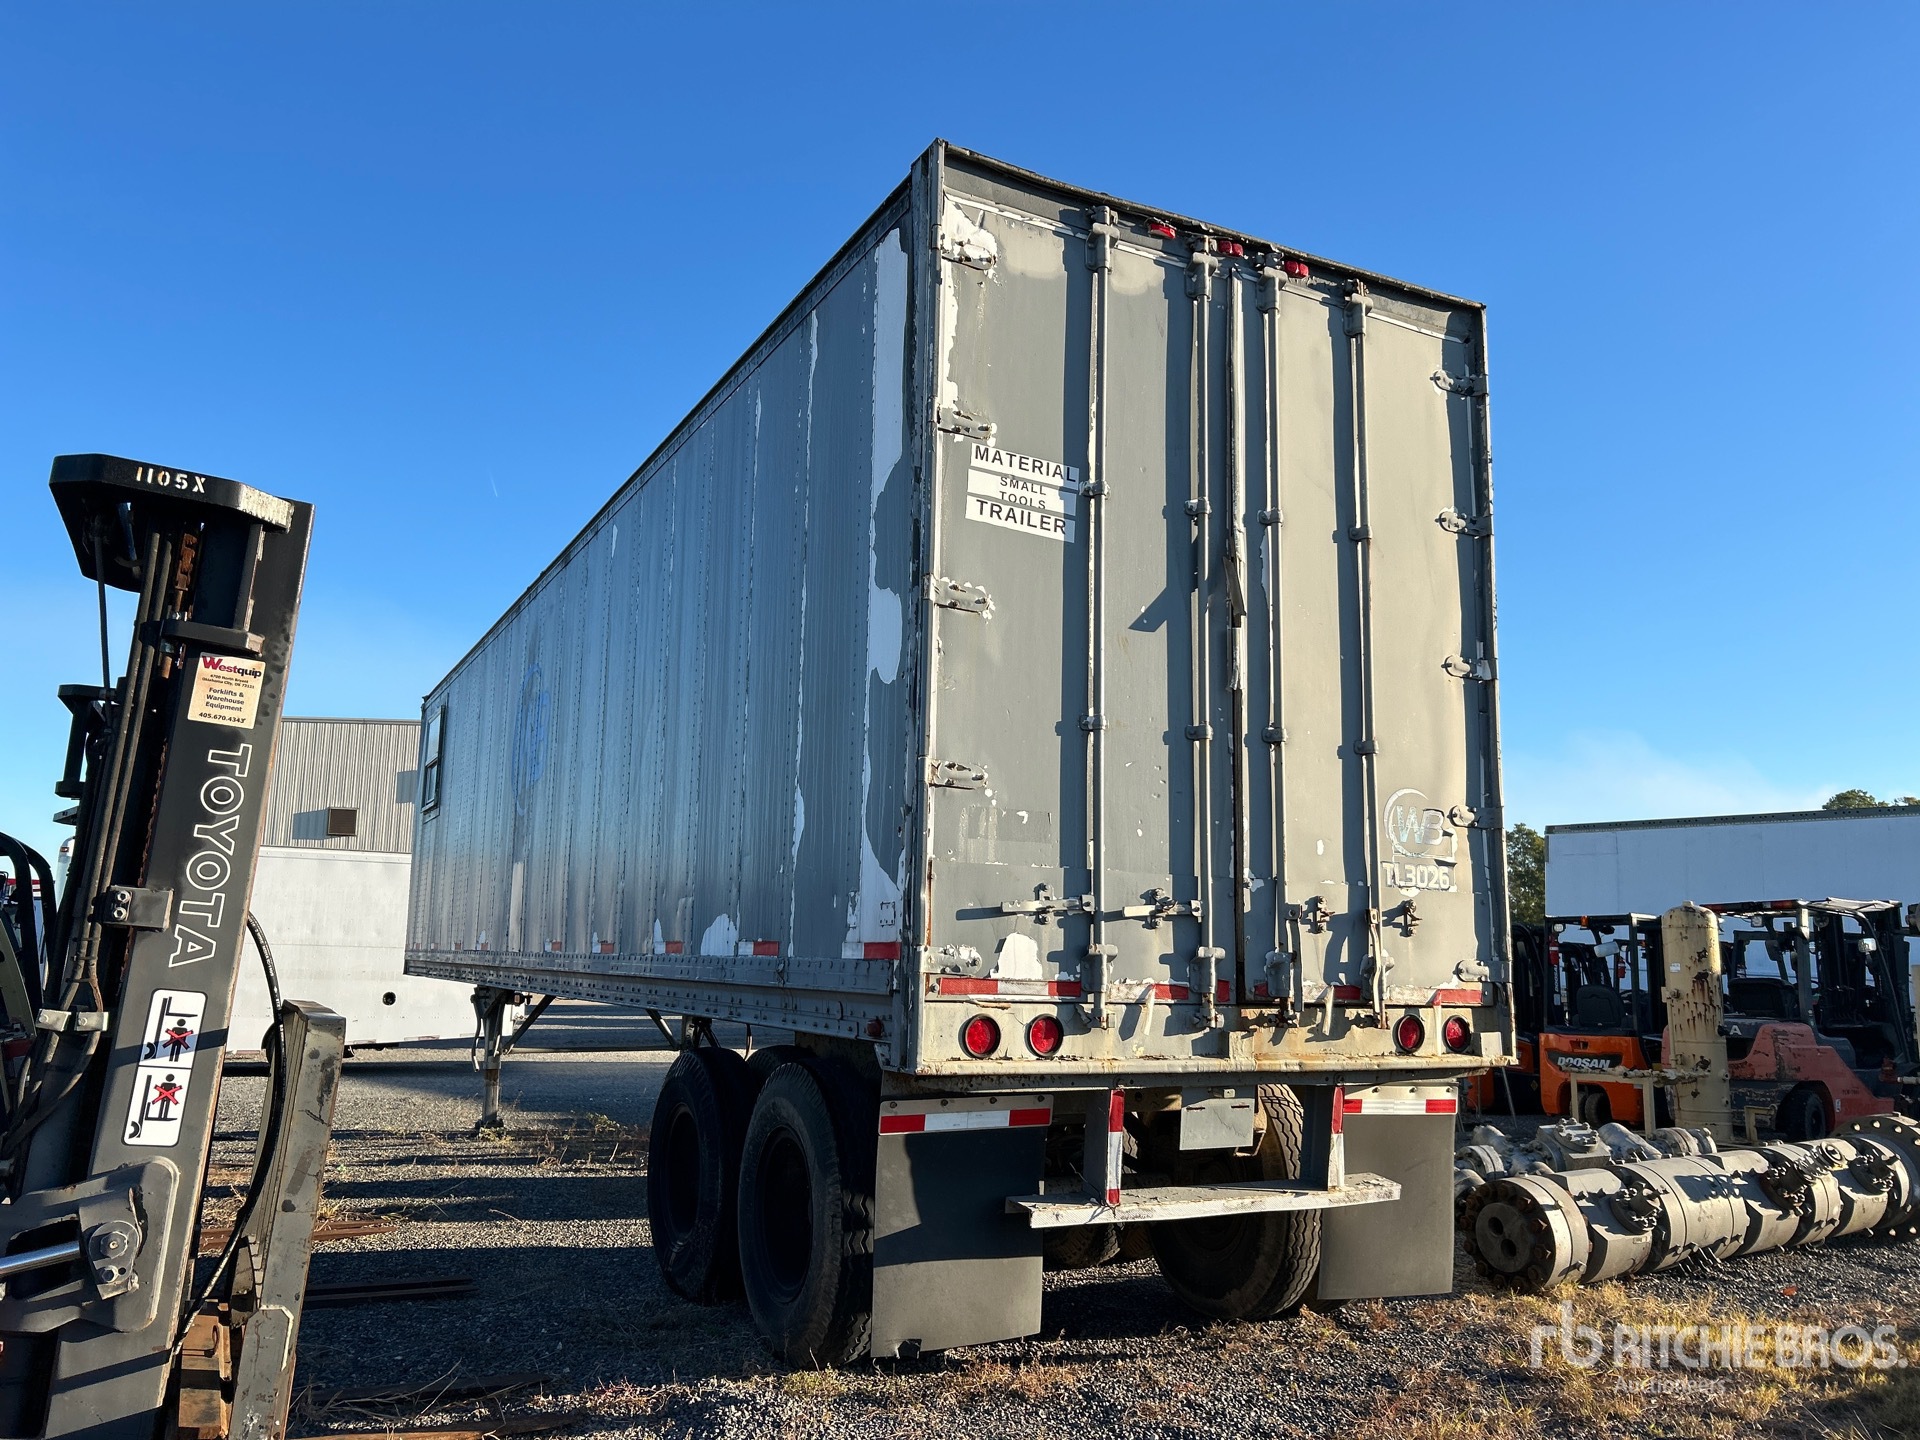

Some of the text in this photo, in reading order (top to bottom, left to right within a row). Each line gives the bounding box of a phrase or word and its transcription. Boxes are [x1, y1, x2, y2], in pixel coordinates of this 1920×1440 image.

[975, 445, 1076, 483] MATERIAL
[136, 466, 206, 494] 1105X
[1000, 476, 1047, 496] SMALL
[999, 490, 1046, 510] TOOLS
[976, 498, 1066, 535] TRAILER
[202, 656, 262, 678] Westquip
[206, 693, 245, 705] Warehouse
[208, 687, 237, 697] Forklifts
[205, 701, 243, 712] Equipment
[168, 743, 252, 968] TOYOTA
[1381, 861, 1451, 891] TL3026
[1557, 1056, 1611, 1070] DOOSAN
